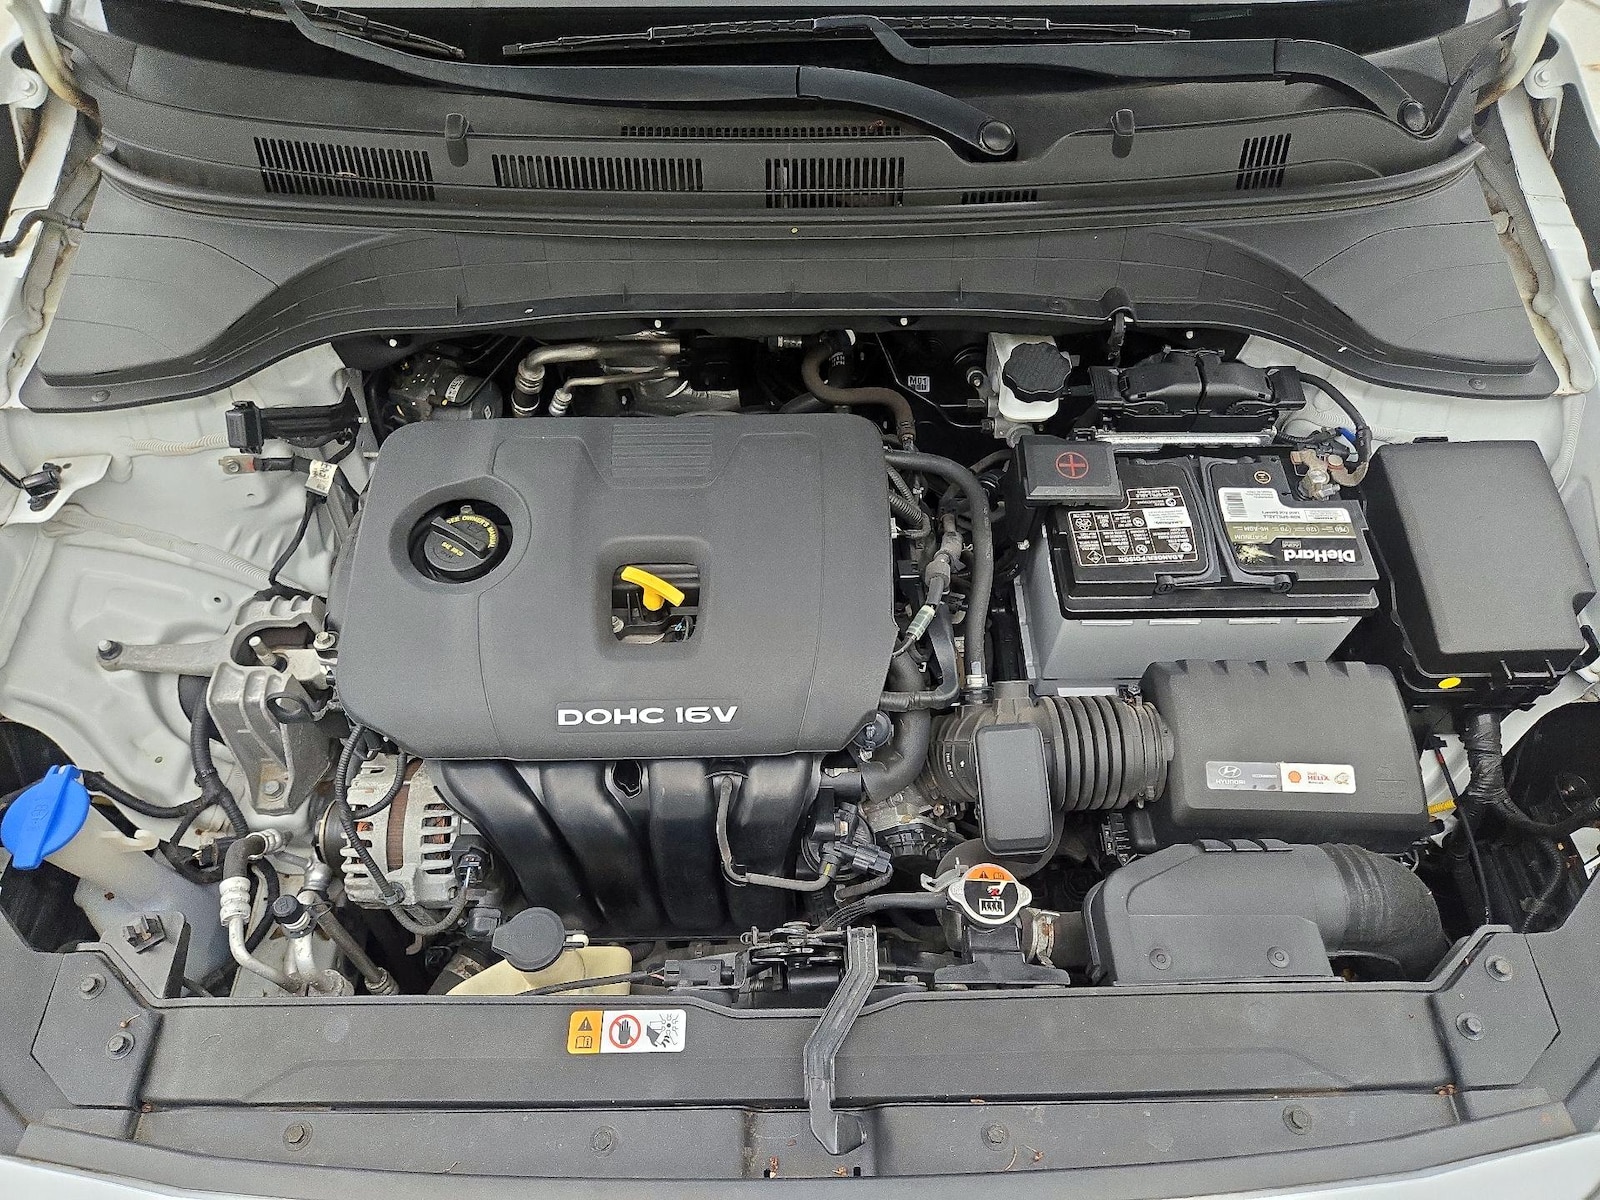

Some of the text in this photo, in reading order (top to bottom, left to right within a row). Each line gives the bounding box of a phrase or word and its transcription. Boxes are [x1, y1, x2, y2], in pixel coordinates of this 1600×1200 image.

[1283, 549, 1356, 562] DieHard
[557, 706, 738, 726] DOHC 16V
